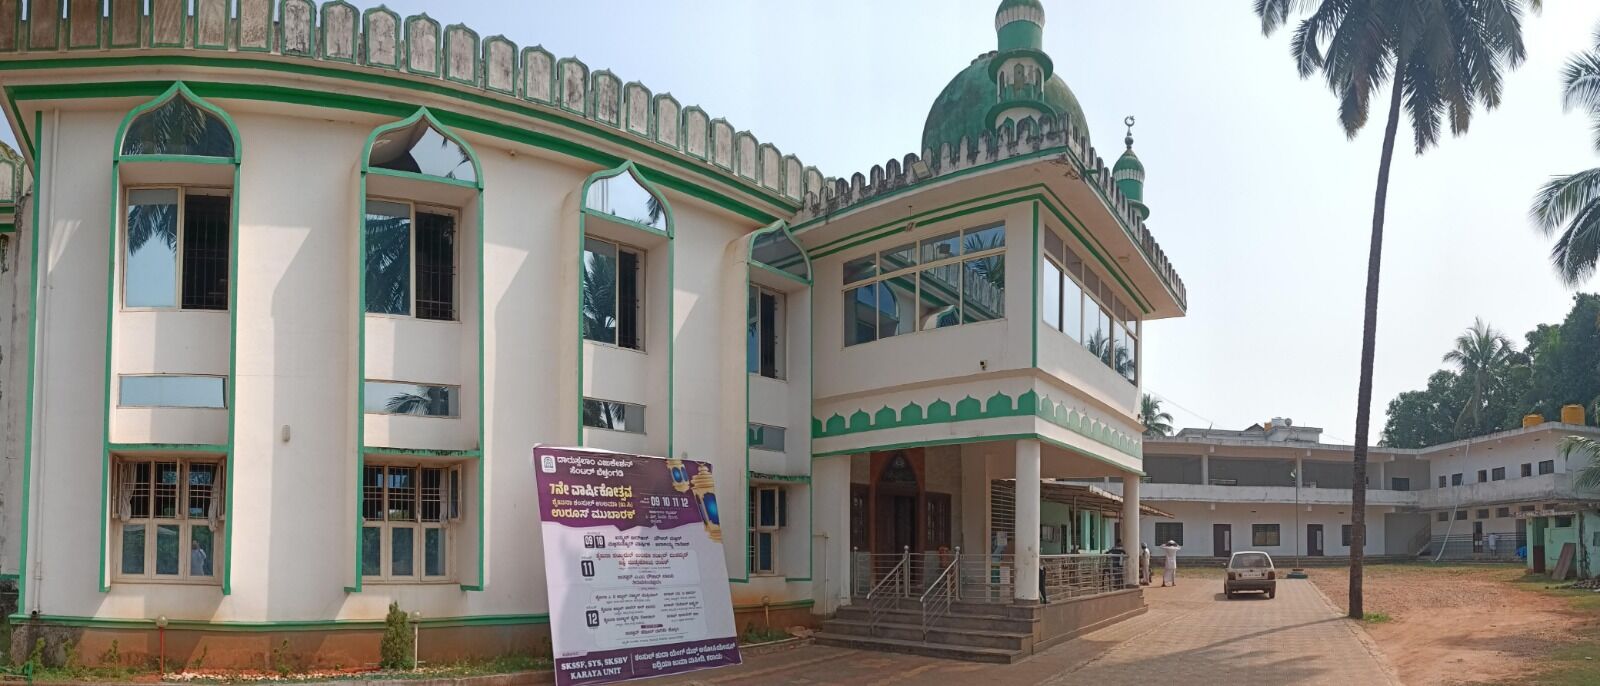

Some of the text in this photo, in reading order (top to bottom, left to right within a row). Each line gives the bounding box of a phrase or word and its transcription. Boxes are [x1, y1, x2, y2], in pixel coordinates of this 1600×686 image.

[549, 481, 569, 495] 7ನೇ
[650, 496, 661, 507] 09
[662, 496, 671, 507] 10
[672, 497, 680, 508] 11
[680, 498, 689, 508] 12
[591, 509, 635, 519] ಮುಬಾರಕ್
[583, 561, 593, 576] 11
[587, 612, 598, 625] 12
[561, 656, 628, 670] SKSSF, SYS, SKSBV
[570, 667, 621, 680] KARAYA UNIT
